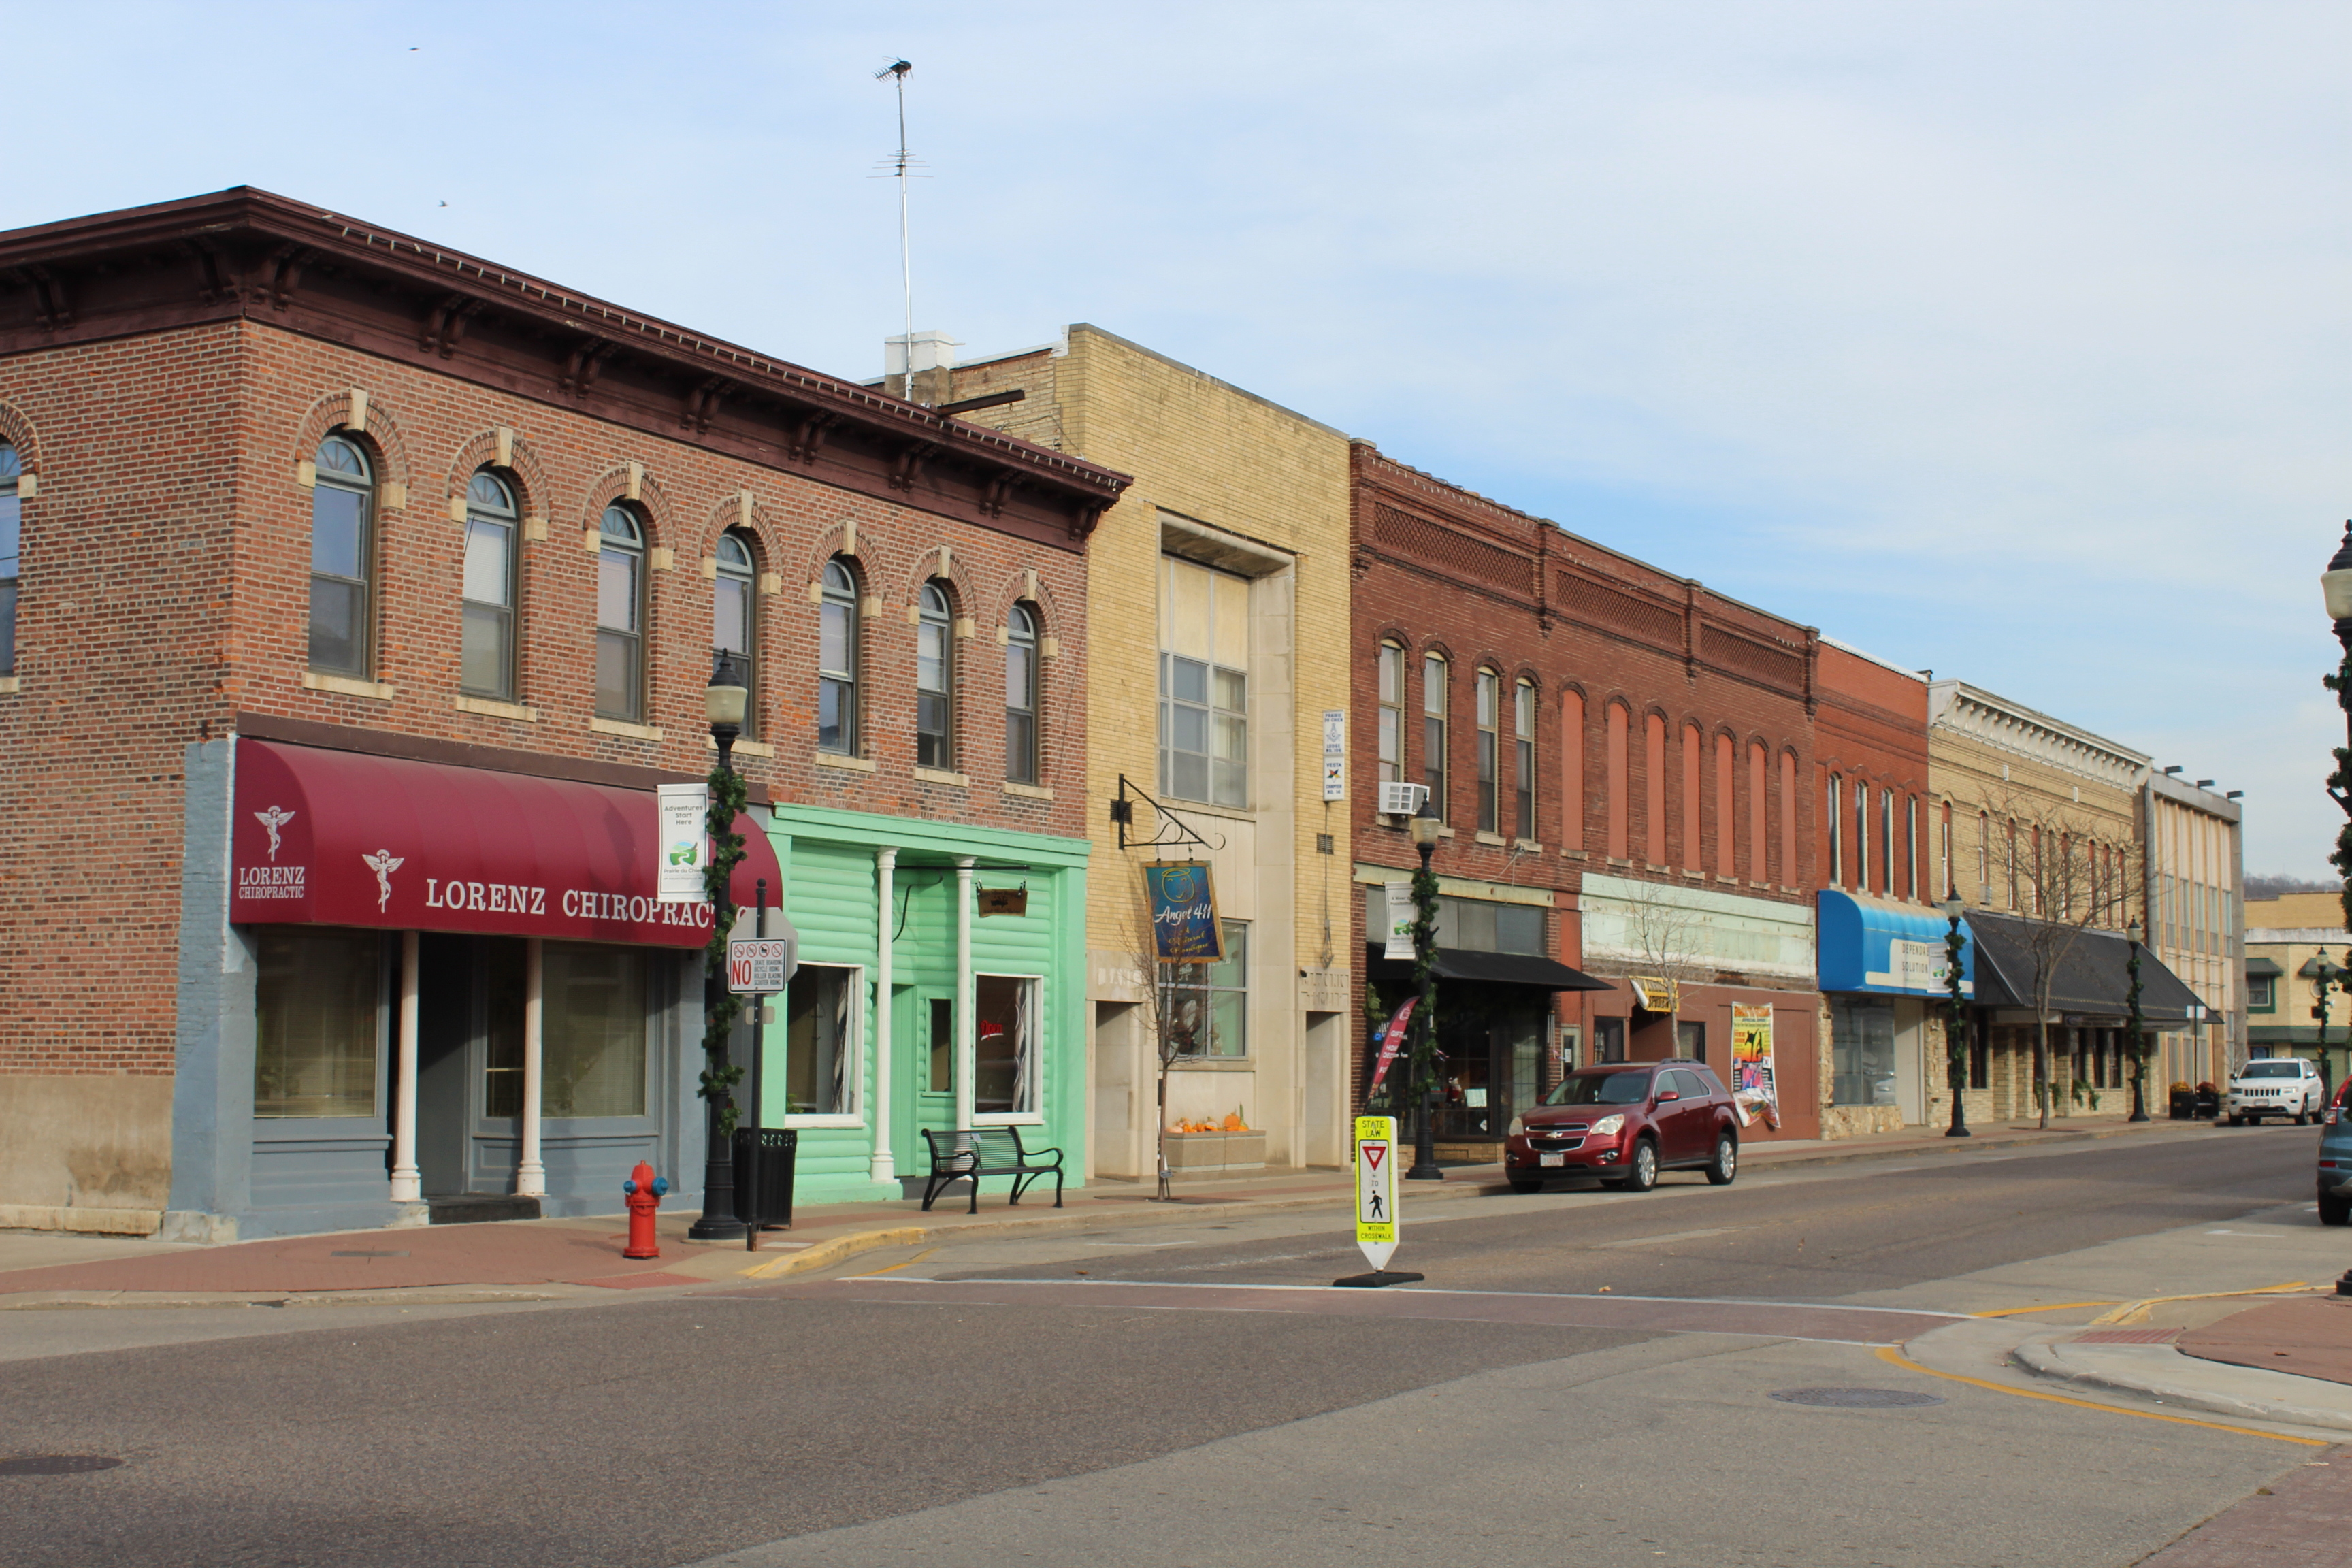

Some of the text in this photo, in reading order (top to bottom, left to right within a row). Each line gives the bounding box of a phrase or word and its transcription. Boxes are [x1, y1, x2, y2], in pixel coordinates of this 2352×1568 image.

[239, 866, 305, 885] LORENZ
[238, 885, 305, 899] CHIROPRACTIC
[426, 878, 749, 928] LORENZ CHIROPRAC
[1154, 903, 1212, 926] Angel 411
[1901, 943, 1929, 956] DEPENDA
[732, 960, 751, 985] NO
[1901, 961, 1928, 973] SOLUTION
[980, 1019, 1003, 1040] Open
[1362, 1120, 1385, 1128] STATE
